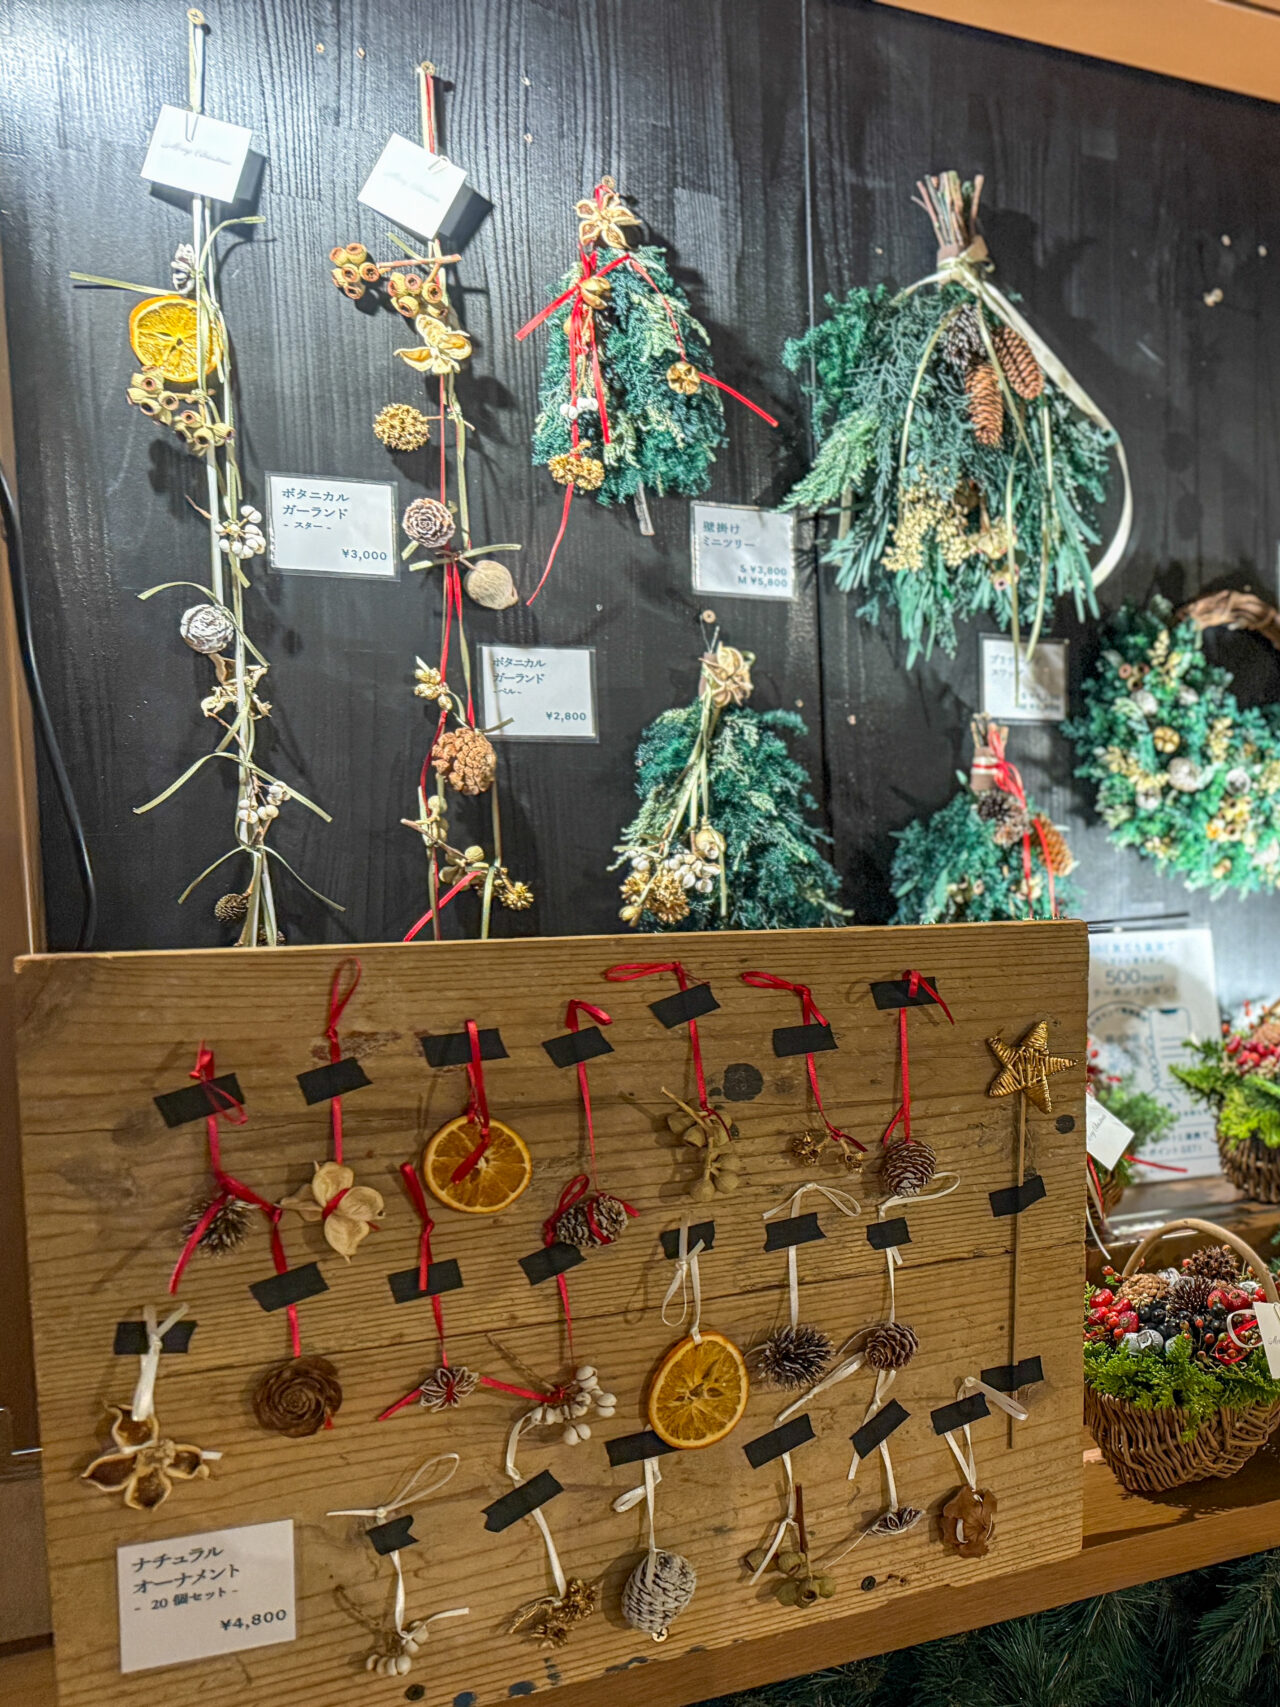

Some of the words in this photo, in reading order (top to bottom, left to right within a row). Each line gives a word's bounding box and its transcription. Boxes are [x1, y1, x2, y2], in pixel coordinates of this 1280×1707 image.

[281, 487, 350, 502] ボタニカル
[282, 504, 349, 520] ガーランド
[341, 548, 388, 562] ¥3,000
[545, 711, 587, 723] ¥2,800
[132, 1546, 225, 1573] ナチュラル
[132, 1564, 240, 1594] オーナメント
[220, 1608, 287, 1631] ¥4,800
